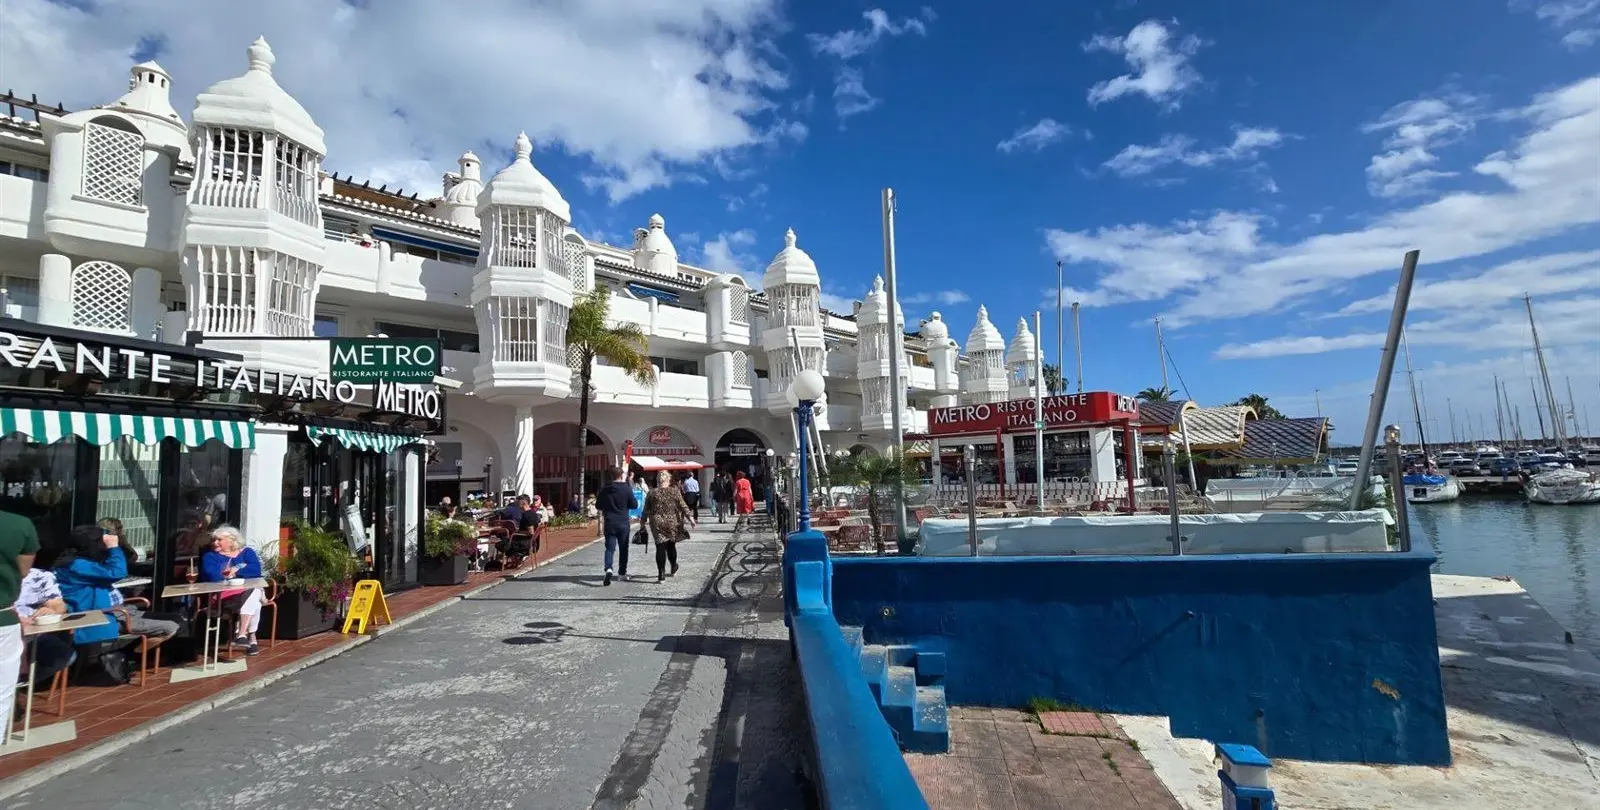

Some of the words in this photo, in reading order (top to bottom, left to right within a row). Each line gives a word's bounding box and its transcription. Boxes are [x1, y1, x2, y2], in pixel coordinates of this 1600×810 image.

[332, 345, 435, 366] METRO
[197, 360, 356, 403] ITALIANO
[376, 378, 438, 419] METRO
[1117, 395, 1137, 413] METRO
[935, 405, 991, 424] METRO
[1007, 410, 1077, 426] ITALANO
